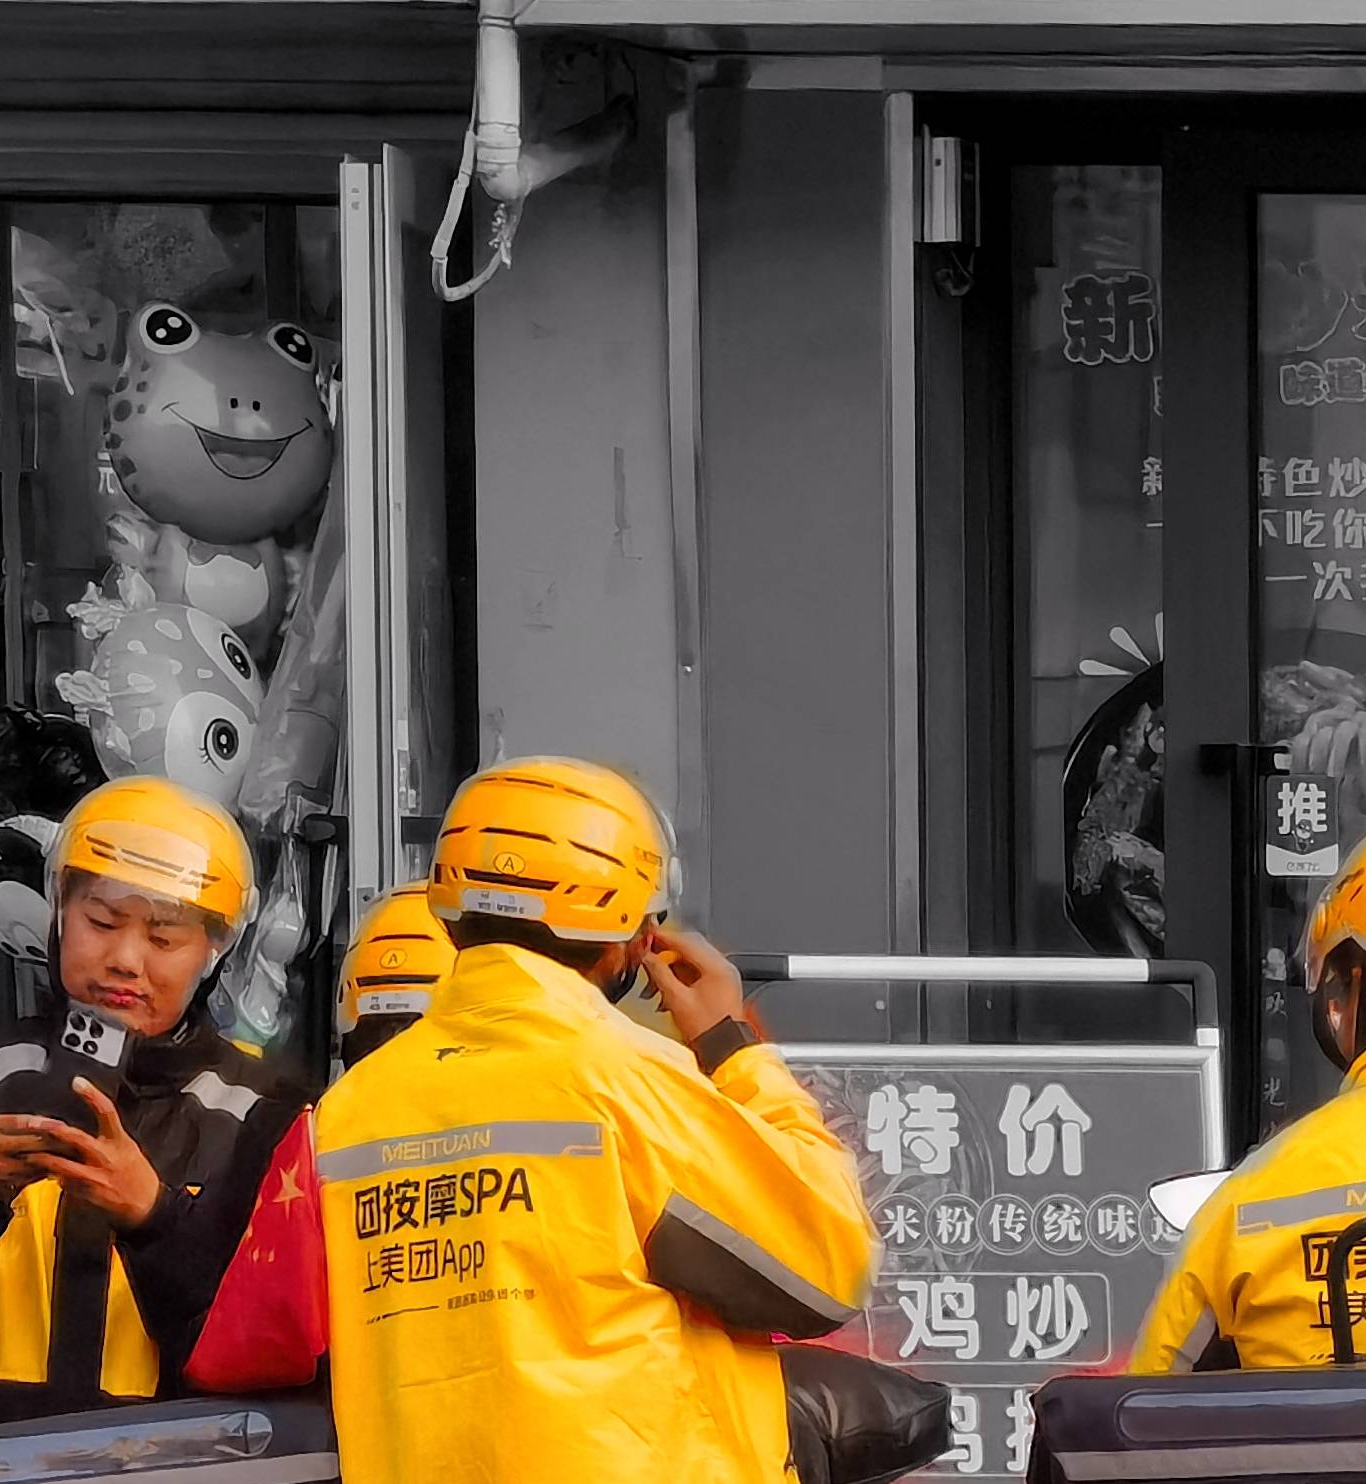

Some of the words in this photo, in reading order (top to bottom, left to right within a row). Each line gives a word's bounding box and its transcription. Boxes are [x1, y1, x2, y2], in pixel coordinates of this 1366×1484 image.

[1062, 272, 1155, 366] 新
[1278, 782, 1327, 835] 推
[382, 1128, 491, 1163] MEITUAN
[867, 1084, 1092, 1176] 特价
[363, 1239, 485, 1293] 上美团App
[897, 1276, 1090, 1360] 鸡炒
